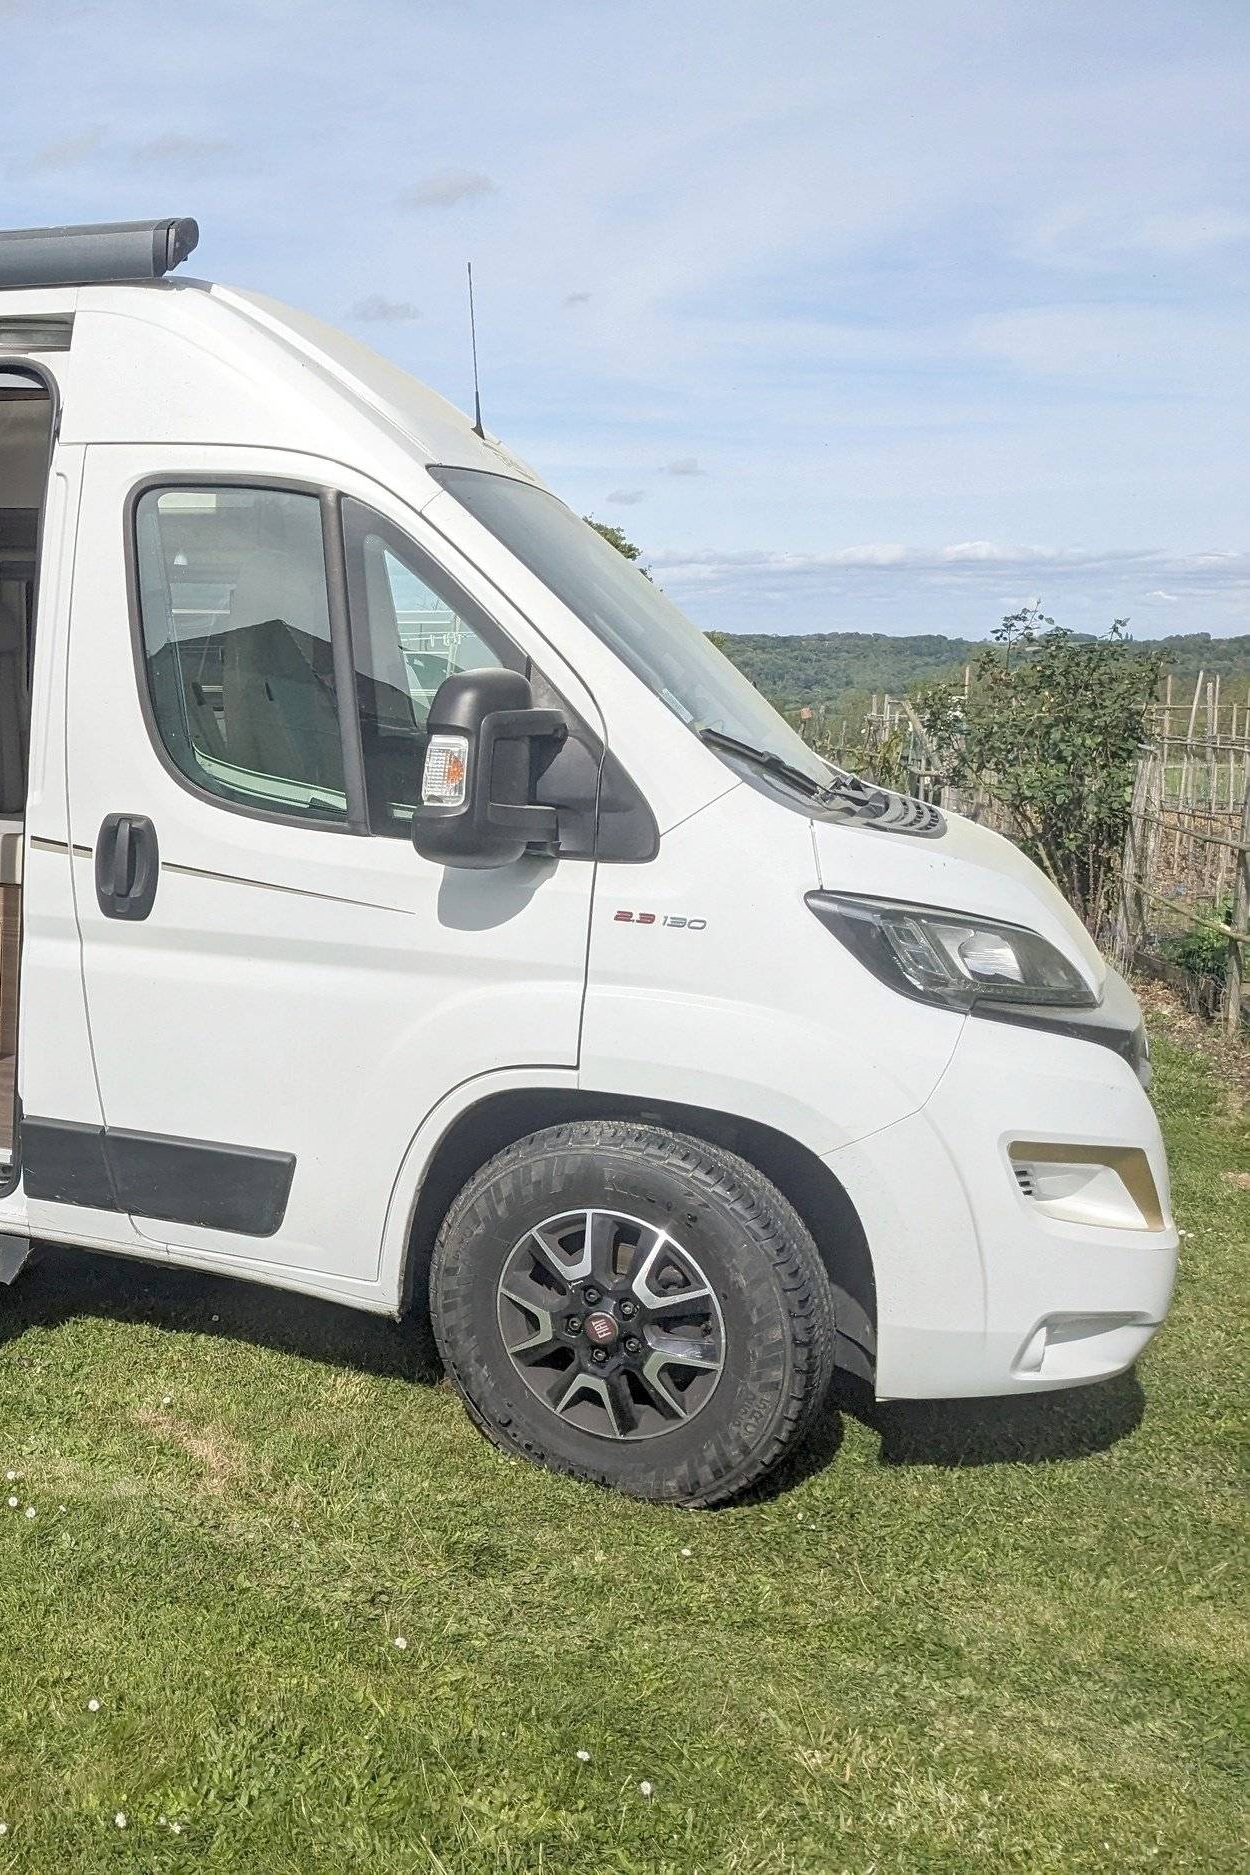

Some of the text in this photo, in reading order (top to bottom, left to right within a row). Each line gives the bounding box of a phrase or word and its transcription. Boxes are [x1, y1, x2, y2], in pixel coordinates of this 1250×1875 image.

[613, 910, 707, 930] 2.3 130
[591, 1319, 612, 1339] FIAT
